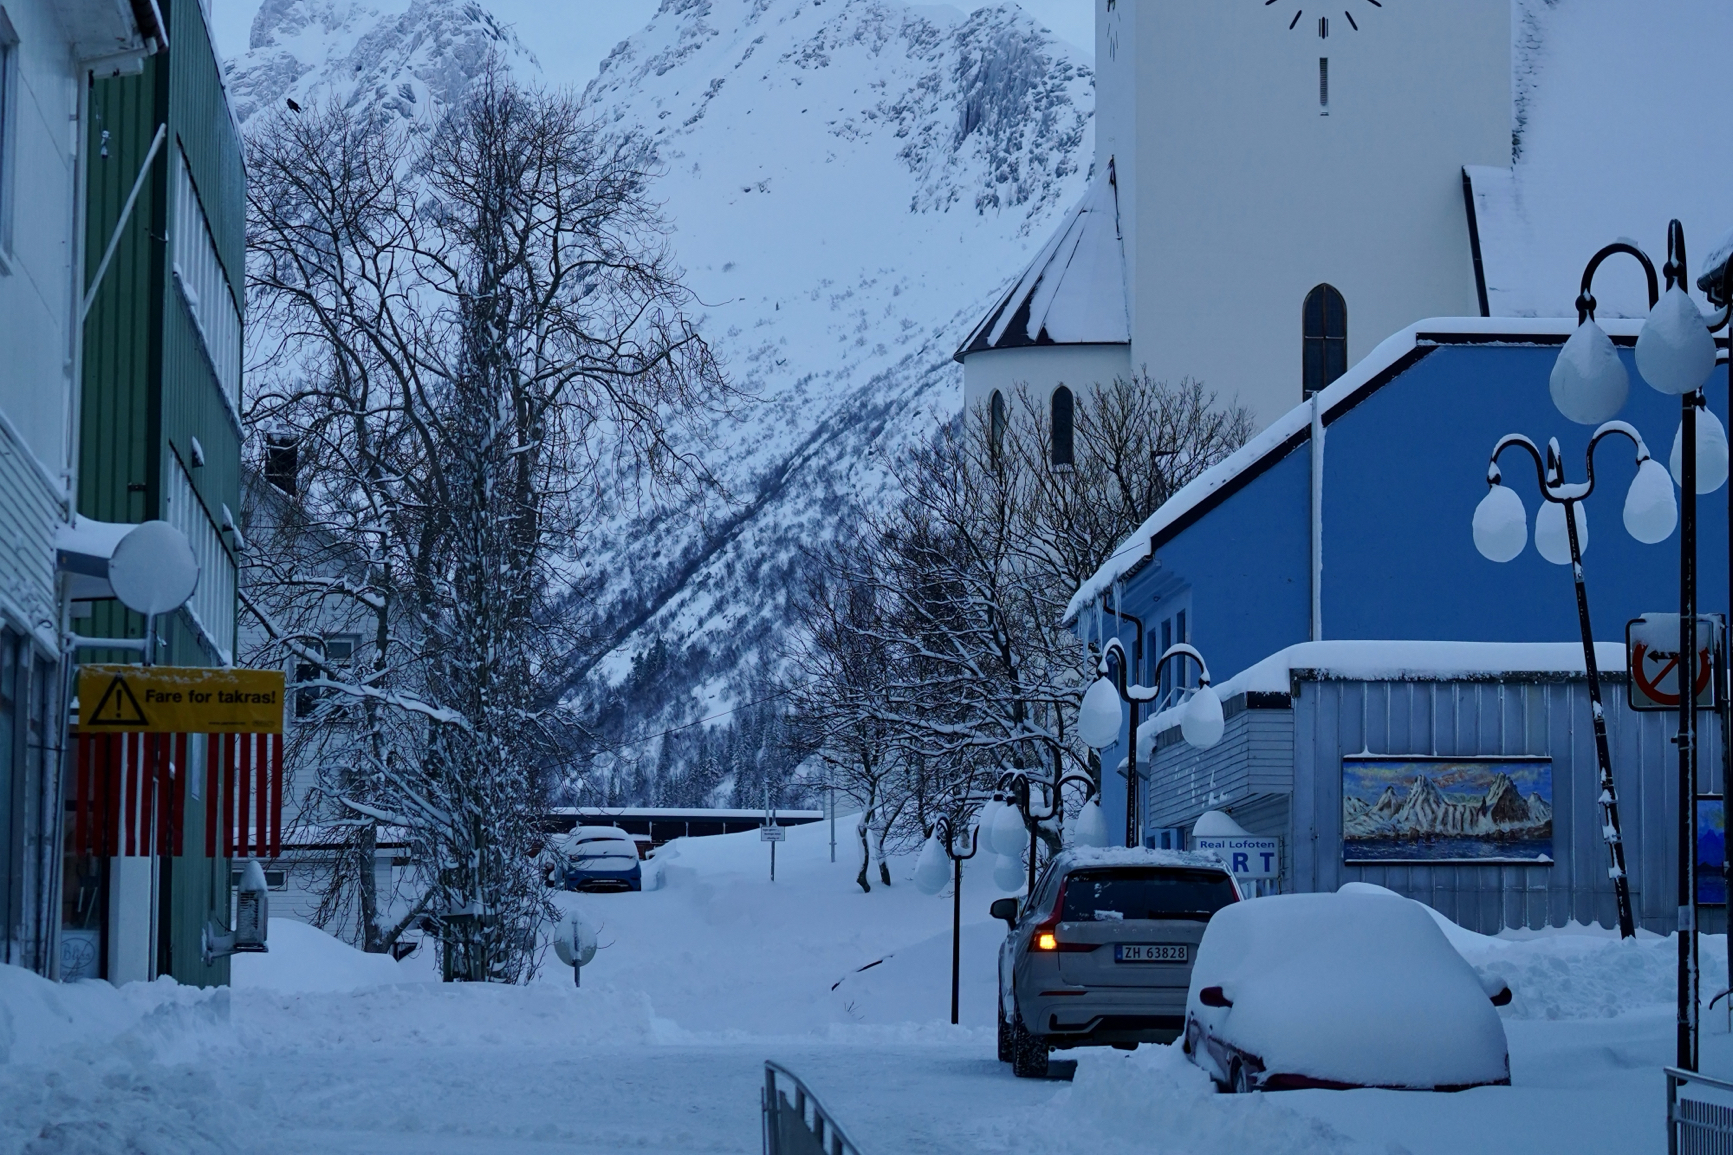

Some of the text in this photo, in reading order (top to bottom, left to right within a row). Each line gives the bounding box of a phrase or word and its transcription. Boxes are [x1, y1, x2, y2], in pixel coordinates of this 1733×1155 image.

[145, 689, 276, 704] Fare for takras!
[1200, 839, 1275, 849] Real Lofoten
[1232, 852, 1275, 873] RT
[1124, 947, 1141, 959] ZH
[1146, 947, 1185, 959] 63828
